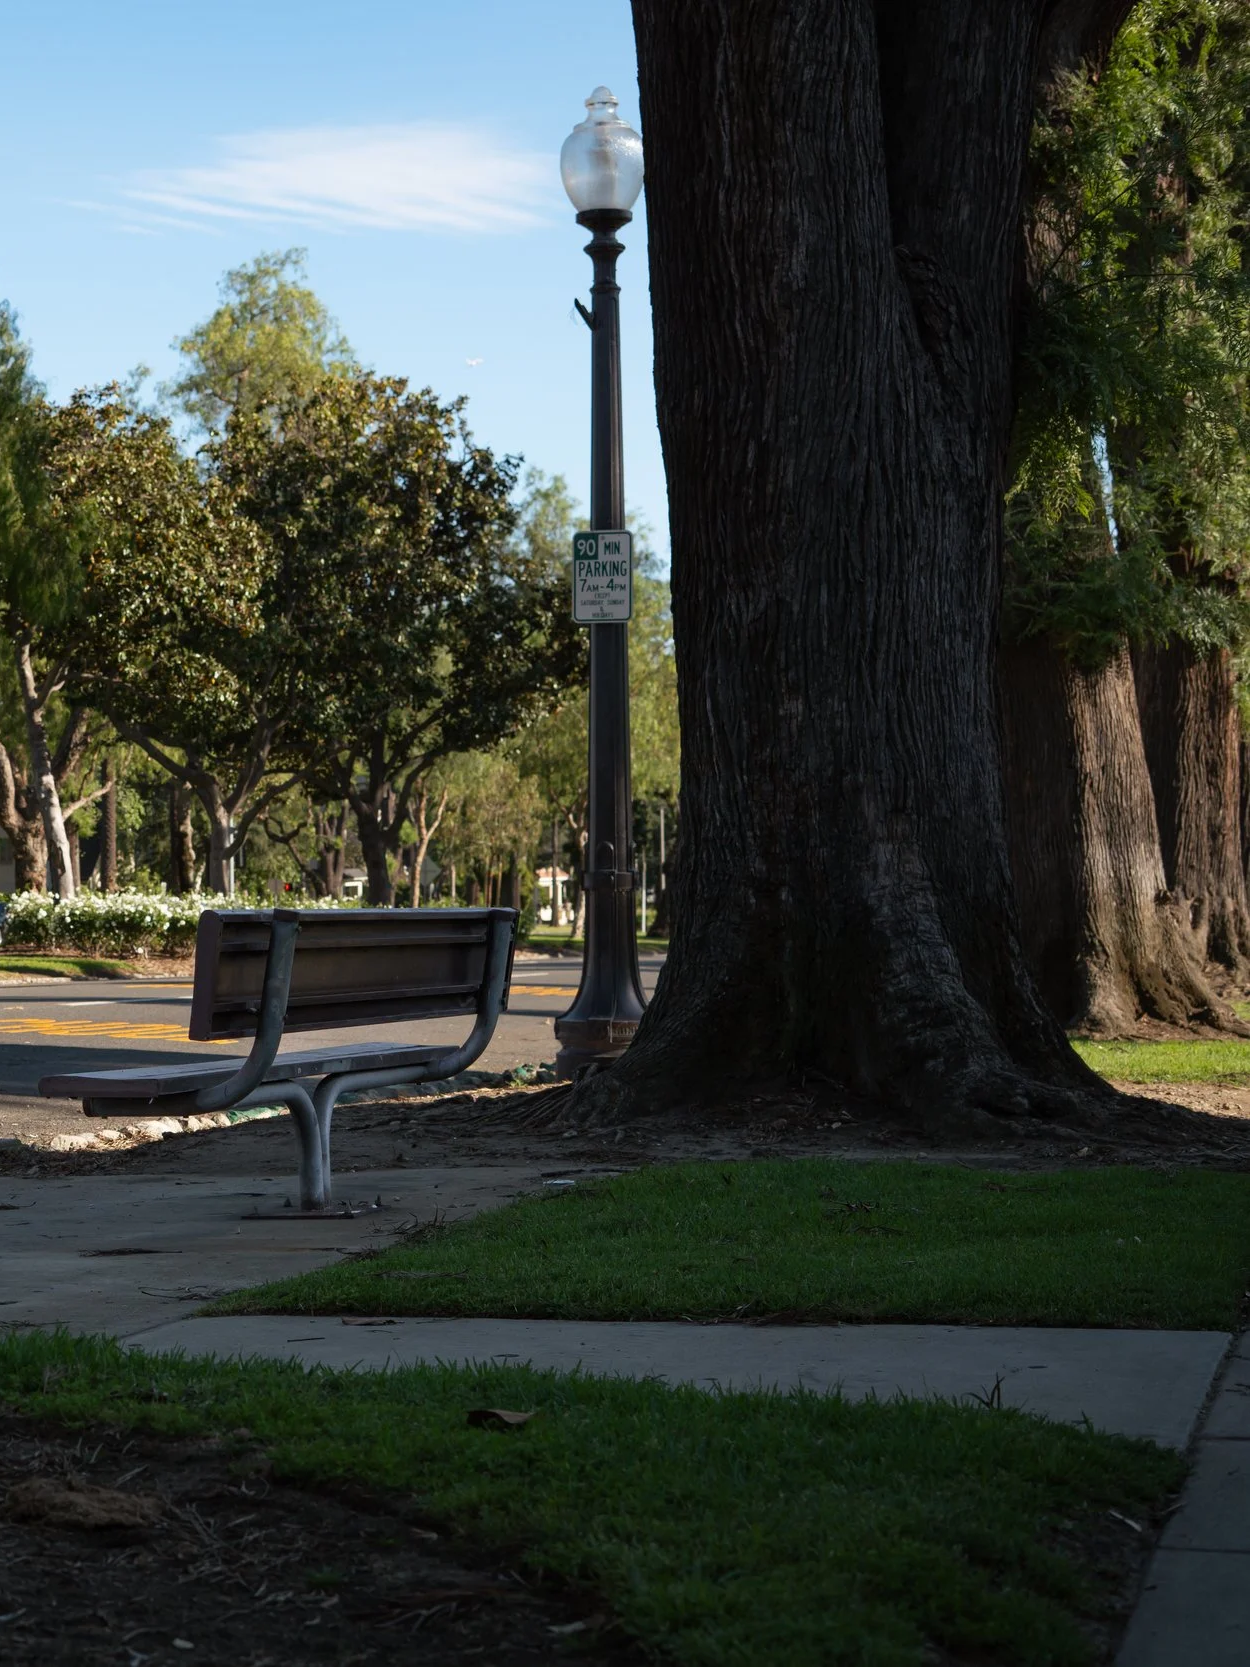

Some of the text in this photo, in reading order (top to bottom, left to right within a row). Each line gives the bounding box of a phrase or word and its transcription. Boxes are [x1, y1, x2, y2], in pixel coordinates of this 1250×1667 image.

[577, 539, 622, 556] 90 MIN.
[578, 560, 627, 578] PARKING
